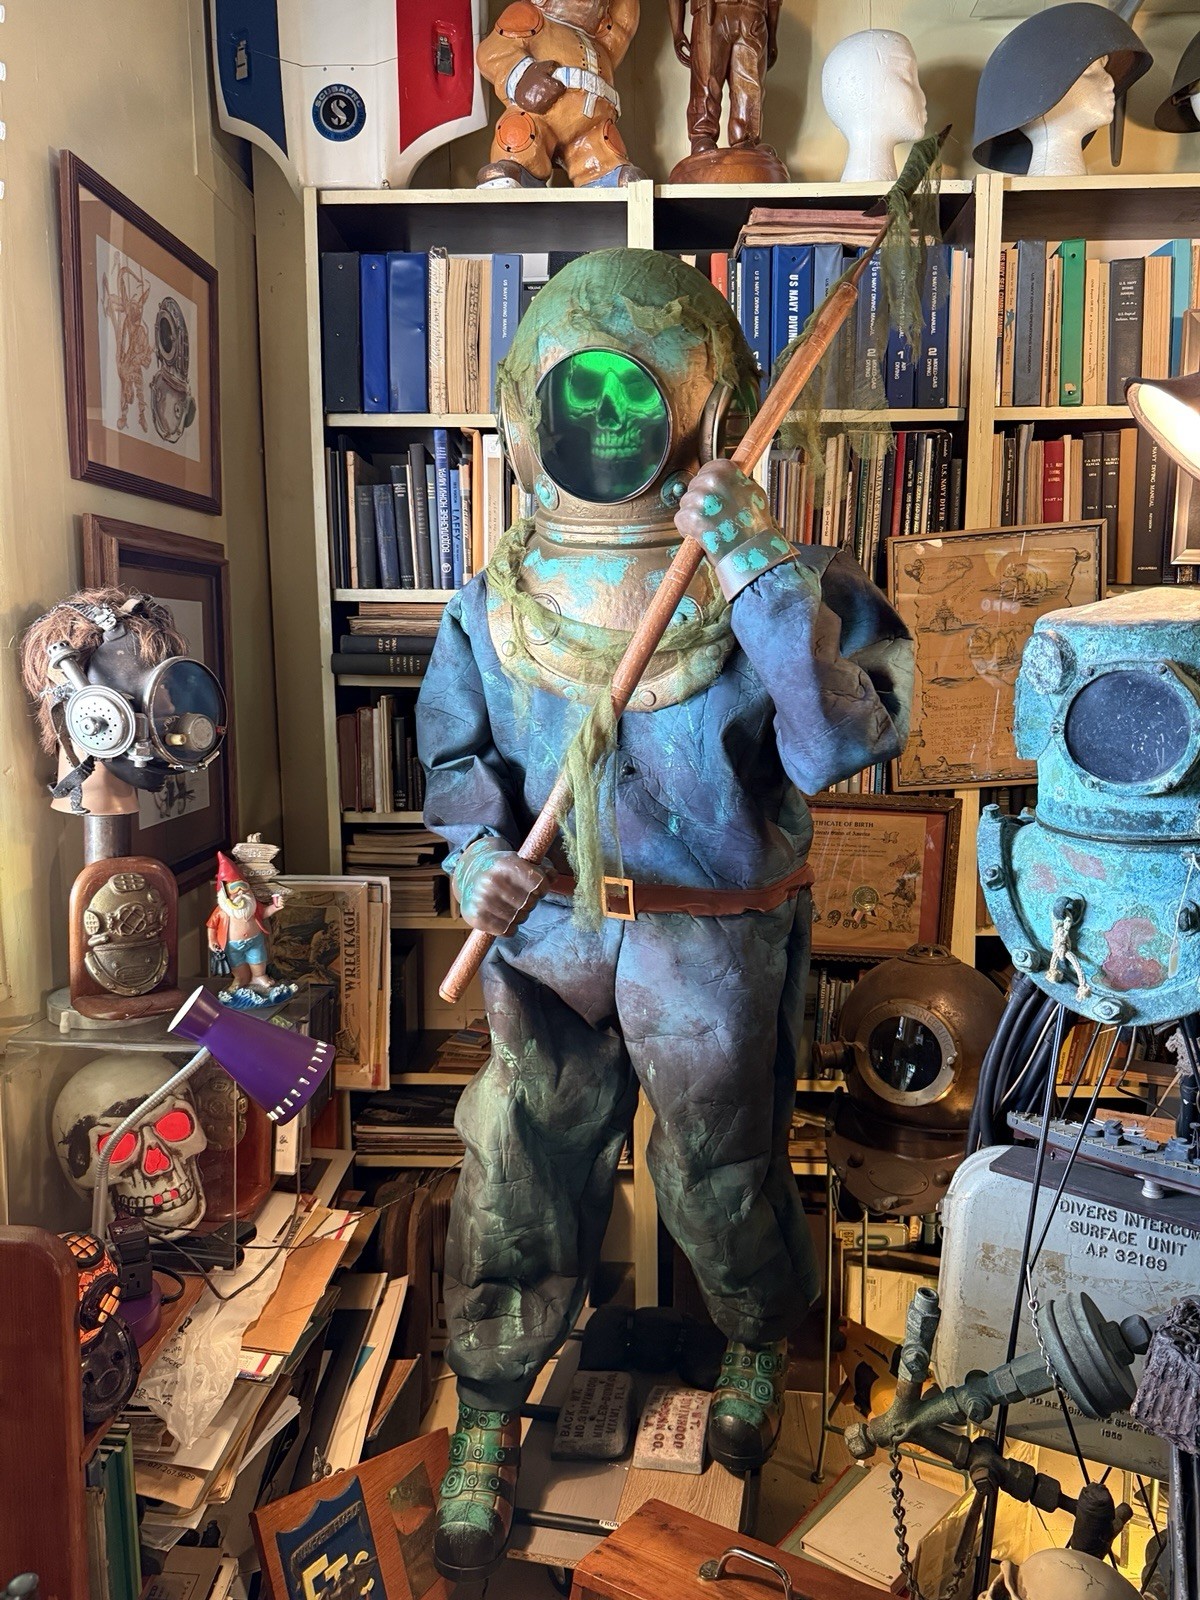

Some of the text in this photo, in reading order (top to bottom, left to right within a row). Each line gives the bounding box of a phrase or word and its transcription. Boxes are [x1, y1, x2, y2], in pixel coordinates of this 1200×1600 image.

[788, 274, 799, 287] US
[788, 289, 799, 312] NAVY
[867, 348, 876, 357] 2
[928, 347, 937, 356] 2
[1148, 484, 1156, 507] MANUAL
[438, 468, 450, 552] ВОДОЛАЗНЫЕ НОЖИ МИРА
[938, 498, 946, 522] DIVER
[452, 509, 460, 541] LAFFY
[872, 513, 880, 545] WESTPAC
[1059, 1198, 1118, 1224] DIVERS
[1069, 1220, 1188, 1258] SURFACE UNIT
[1114, 1248, 1168, 1272] 32189
[559, 1410, 575, 1438] BACK
